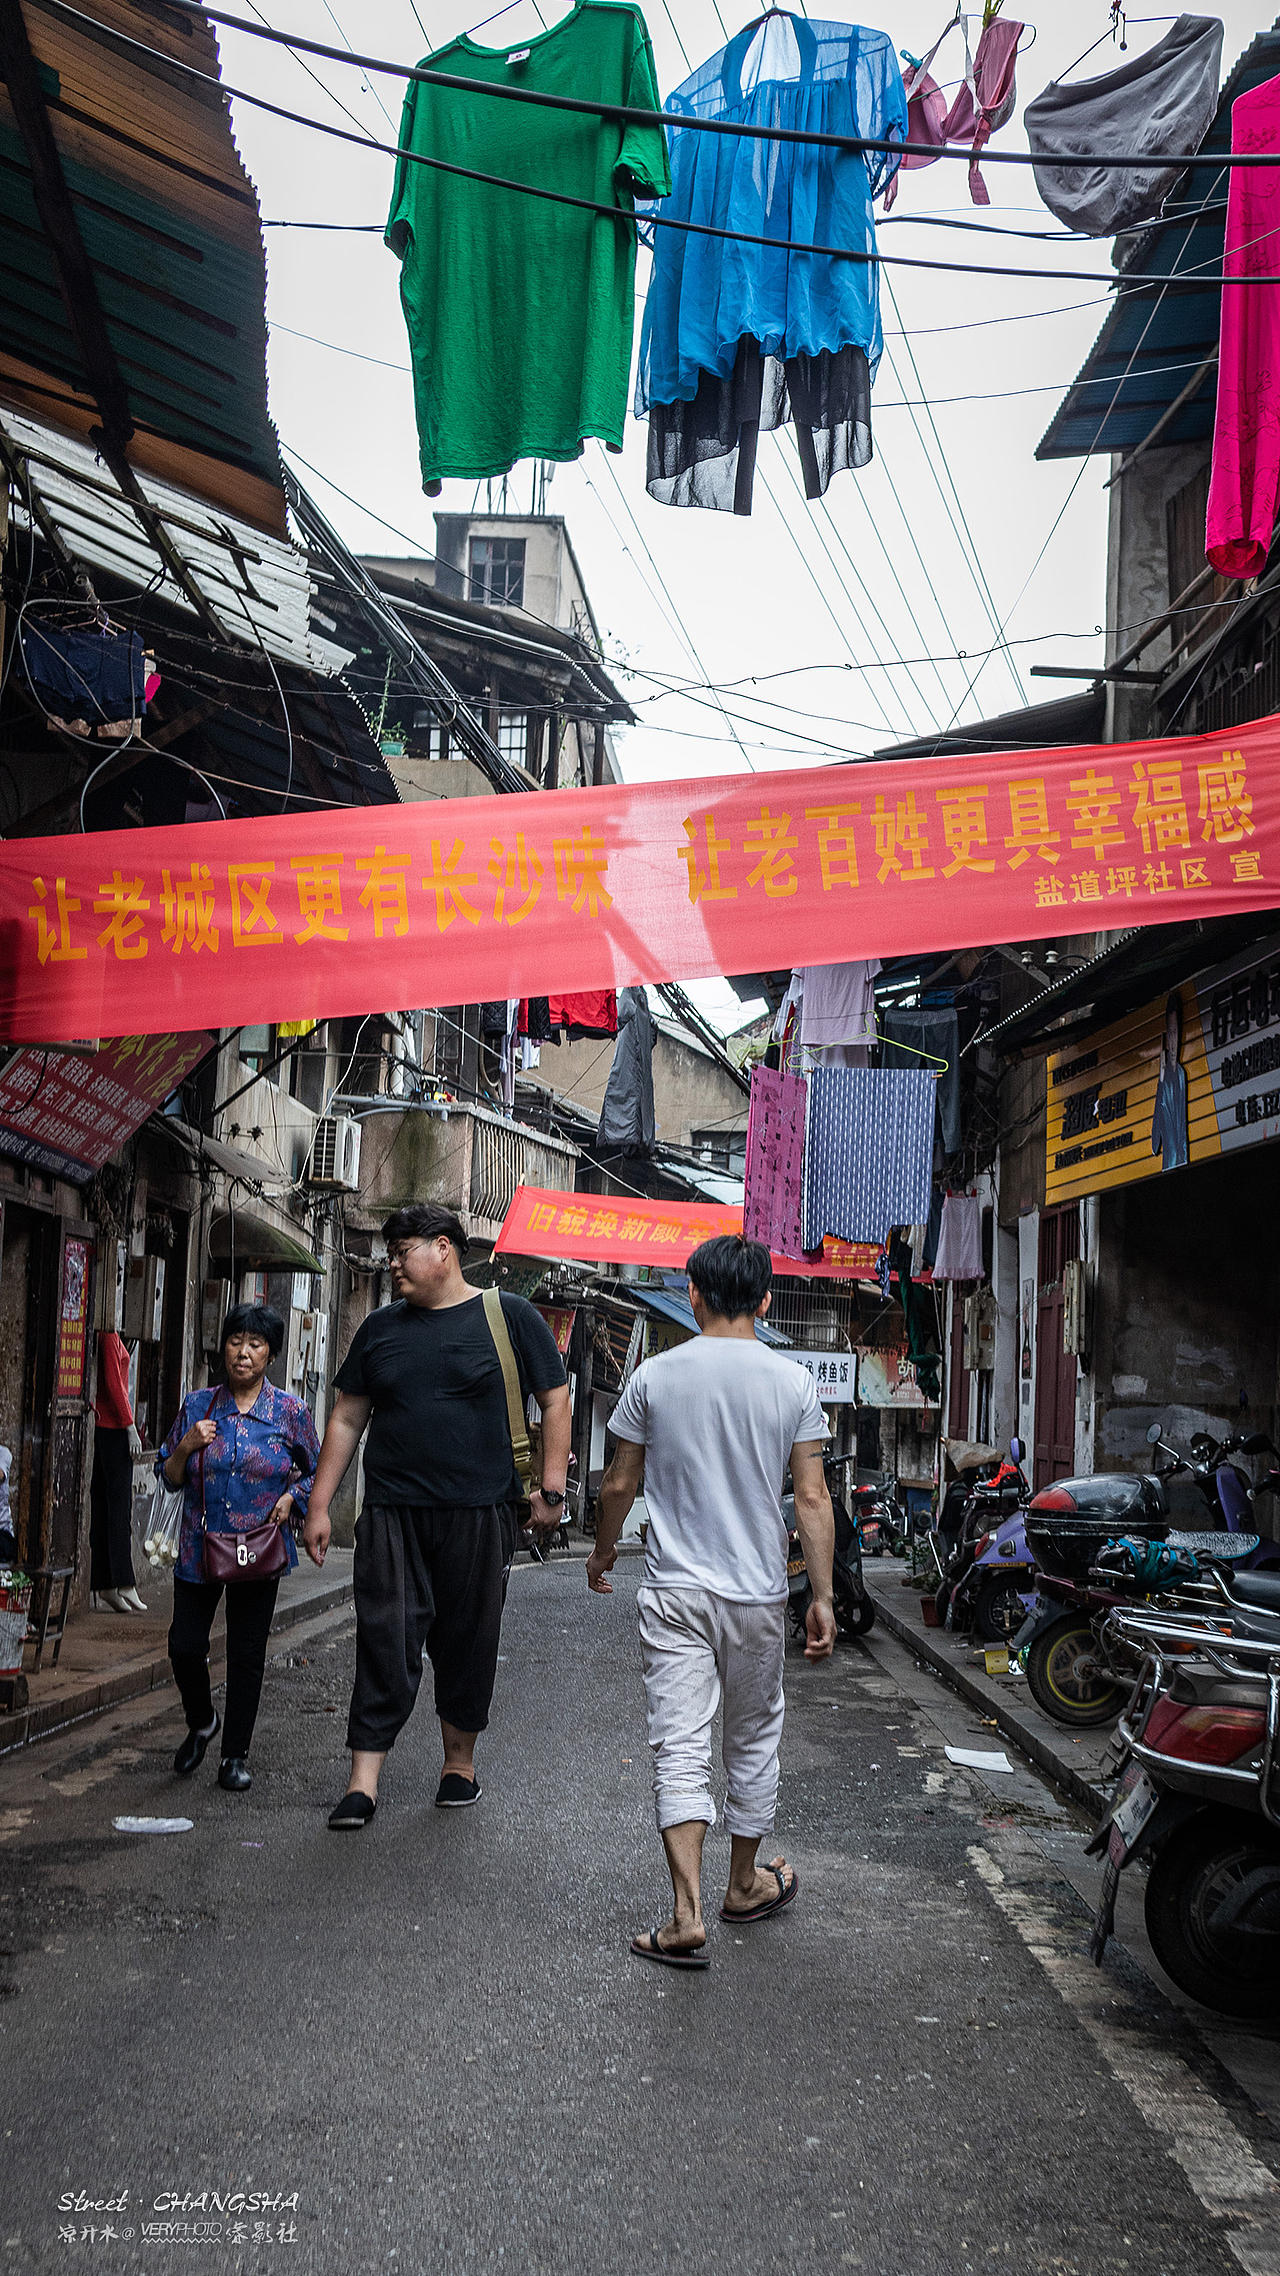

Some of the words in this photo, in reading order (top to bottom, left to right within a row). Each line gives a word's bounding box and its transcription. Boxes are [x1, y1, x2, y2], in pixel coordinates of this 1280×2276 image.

[28, 825, 614, 967] 让老城区更有长沙味
[677, 749, 1256, 905] 让老百姓更具幸福感
[1033, 856, 1212, 909] 盐道坪社区
[1231, 850, 1264, 884] 宣
[817, 1360, 849, 1384] 烤鱼饭
